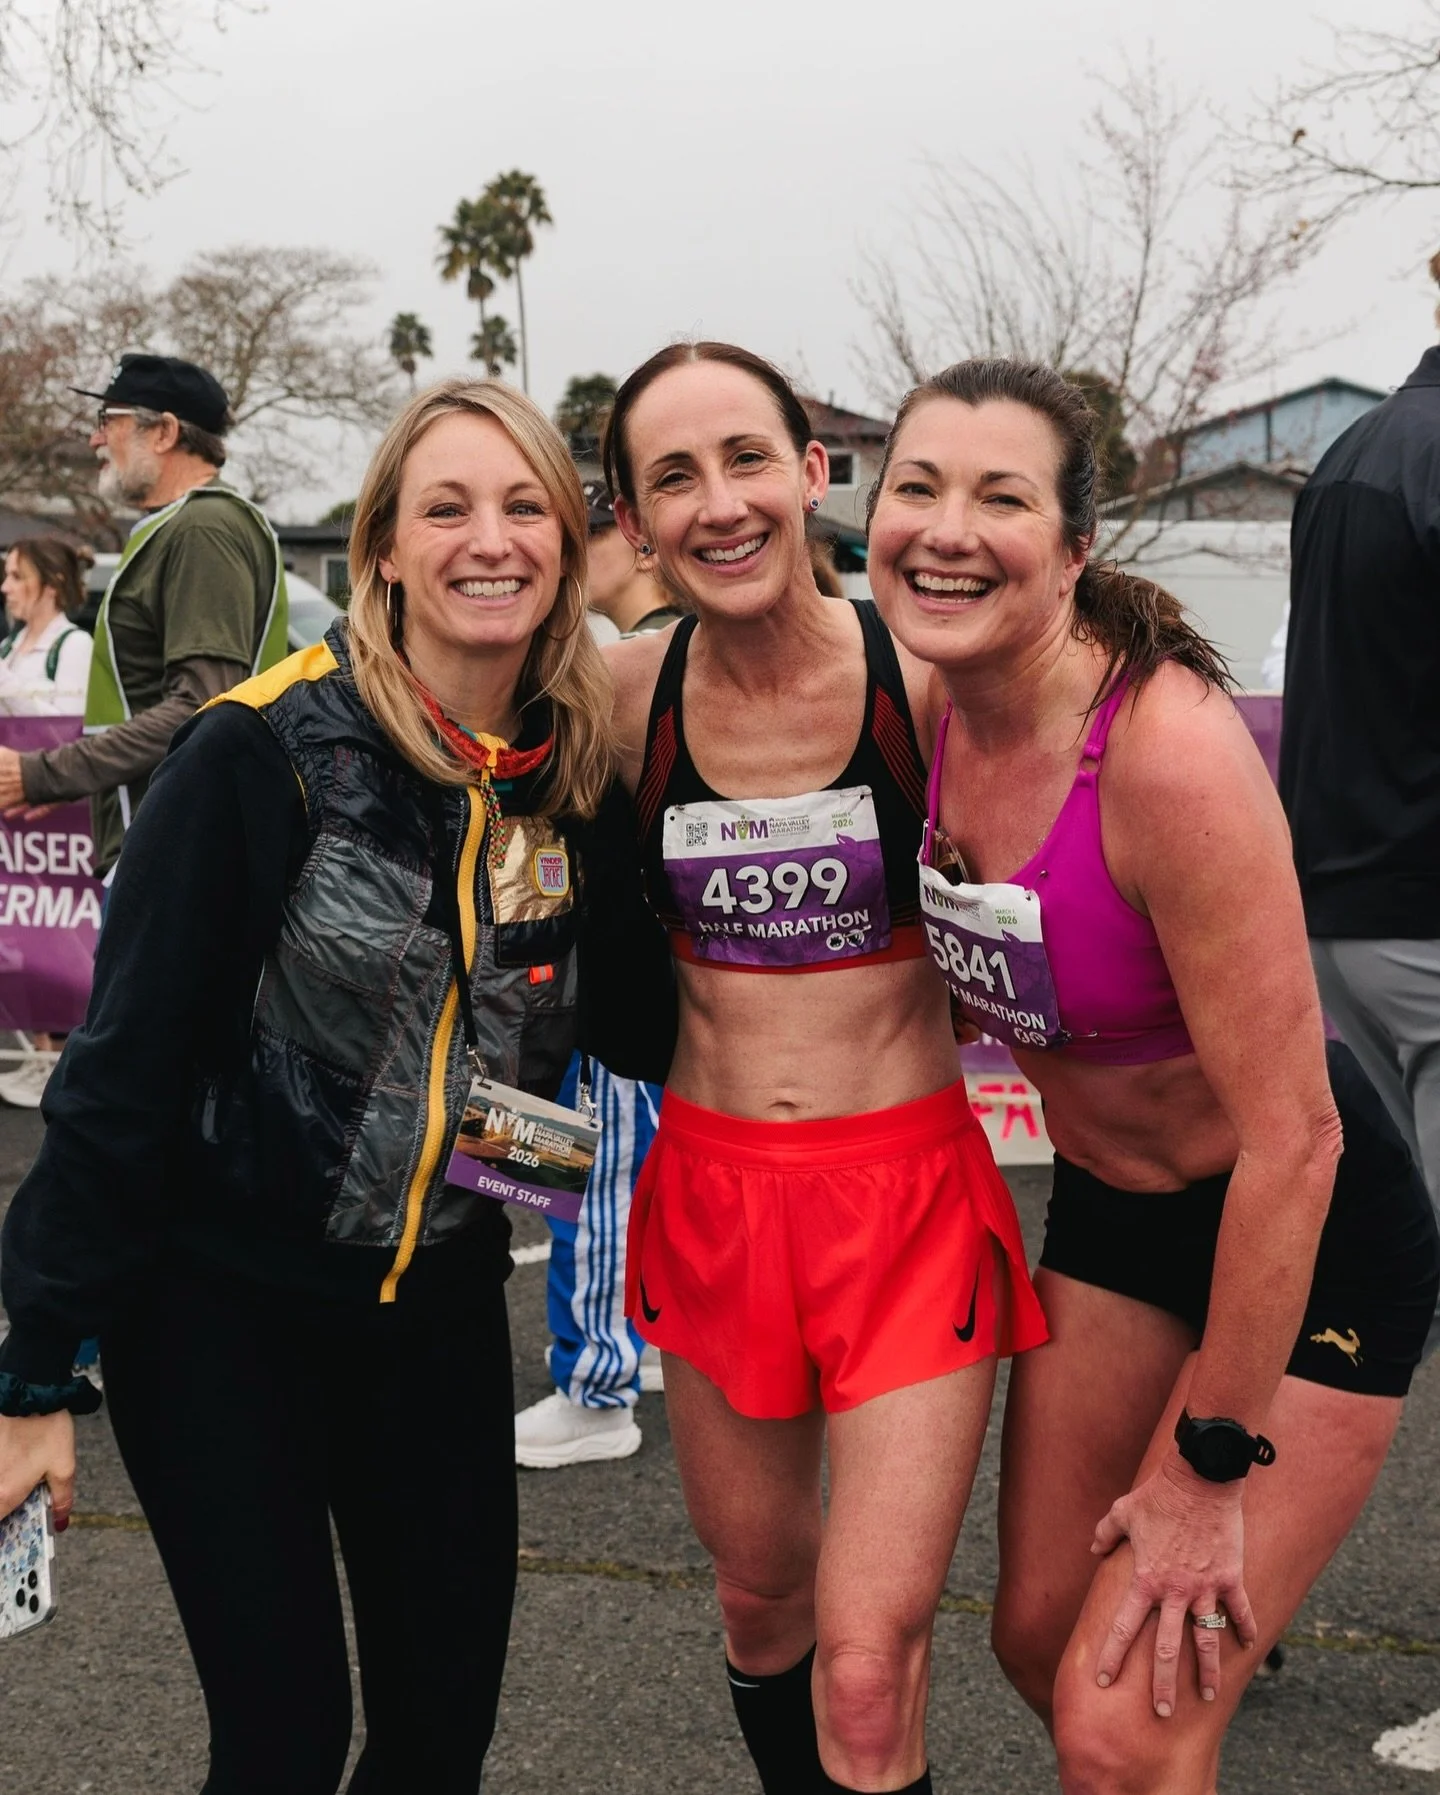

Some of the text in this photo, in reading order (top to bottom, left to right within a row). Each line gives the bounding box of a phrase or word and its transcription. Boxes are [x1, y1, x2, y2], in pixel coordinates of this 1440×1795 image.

[769, 818, 810, 828] NAPA VALLEY
[770, 825, 810, 834] MARATHON
[832, 818, 854, 829] 2026
[701, 858, 848, 915] 4399
[698, 909, 869, 939] HALF MARATHON
[996, 915, 1018, 925] 2026
[924, 921, 1017, 1000] 5841
[959, 988, 1047, 1030] MARATHON
[507, 1145, 540, 1168] 2026
[477, 1175, 552, 1209] EVENT STAFF
